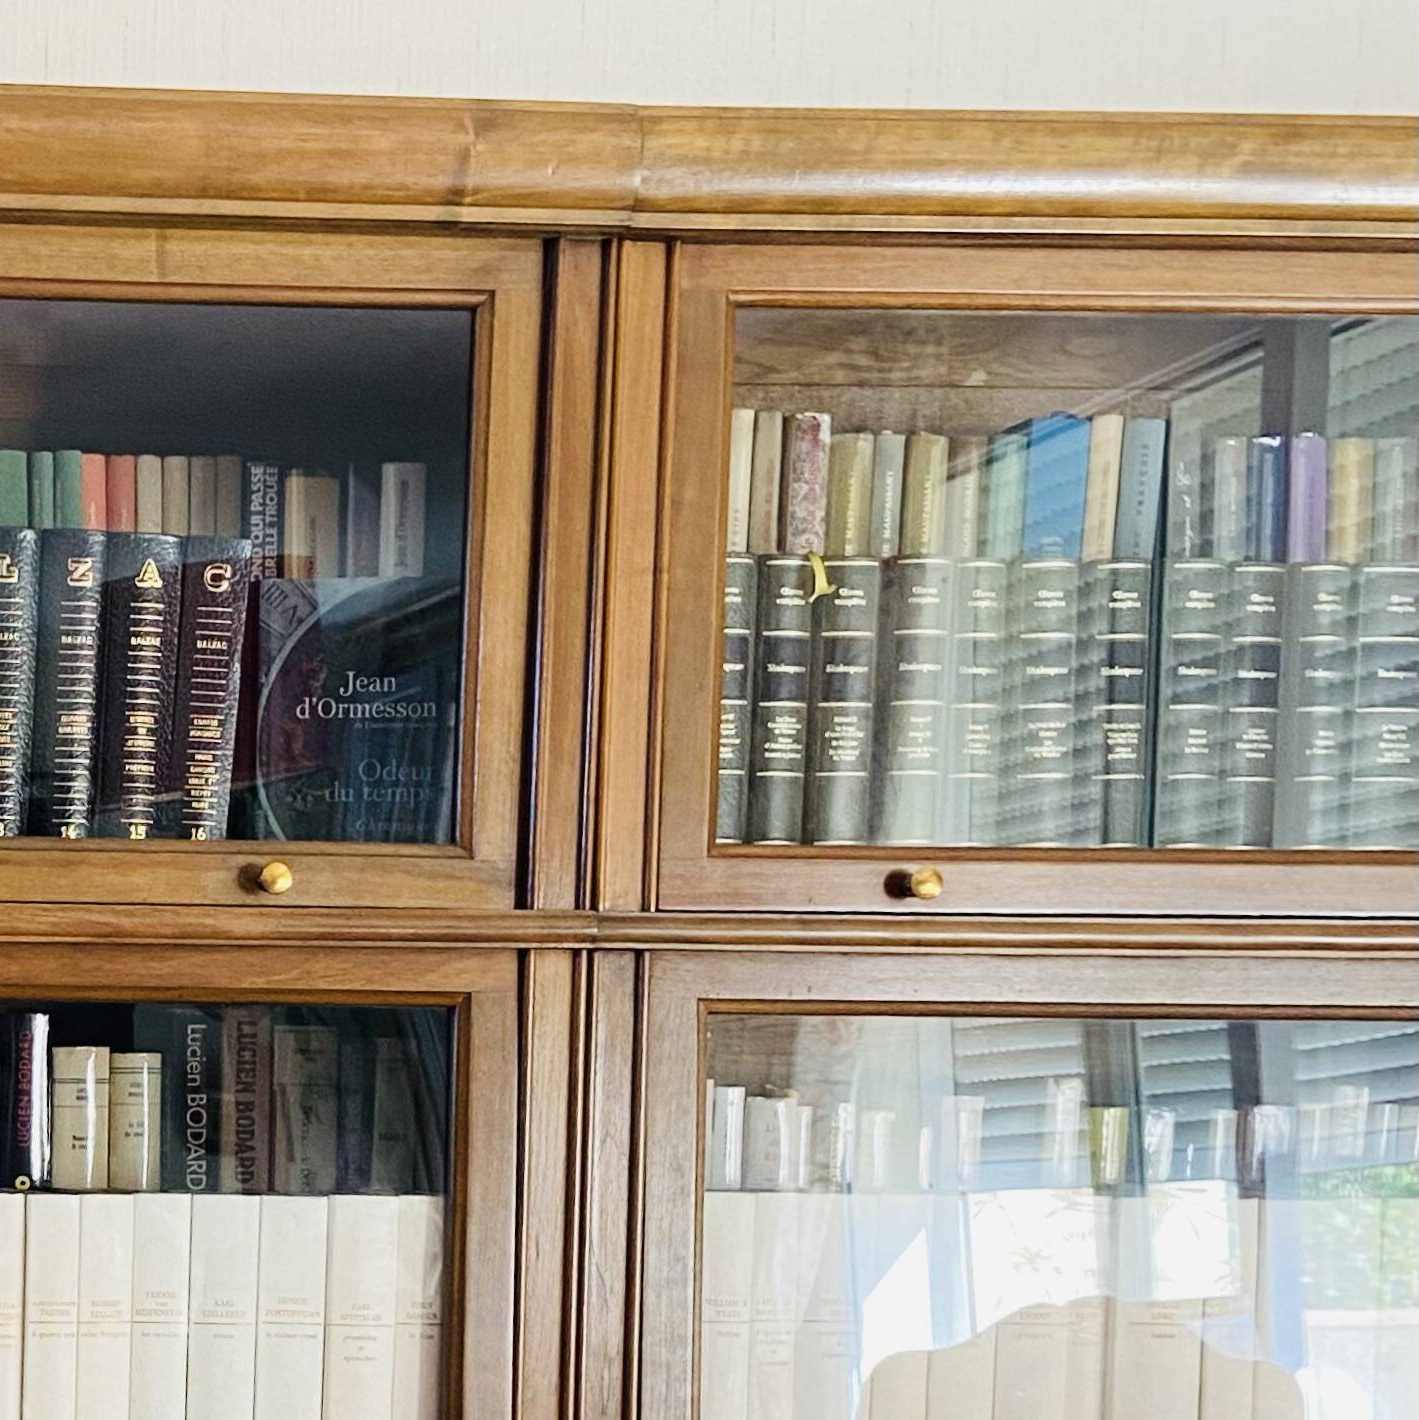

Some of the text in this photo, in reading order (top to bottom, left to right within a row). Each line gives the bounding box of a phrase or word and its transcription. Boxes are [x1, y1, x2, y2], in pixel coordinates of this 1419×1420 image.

[250, 465, 264, 511] PASSE
[250, 514, 264, 544] QUI
[339, 670, 396, 697] Jean
[295, 697, 437, 720] d'Ormesson
[129, 825, 146, 840] 15
[191, 827, 207, 841] 16
[17, 1030, 32, 1148] LUCIEN BODARD
[234, 1019, 258, 1184] LUCIEN BODARD
[186, 1023, 208, 1190] Lucien BODARD
